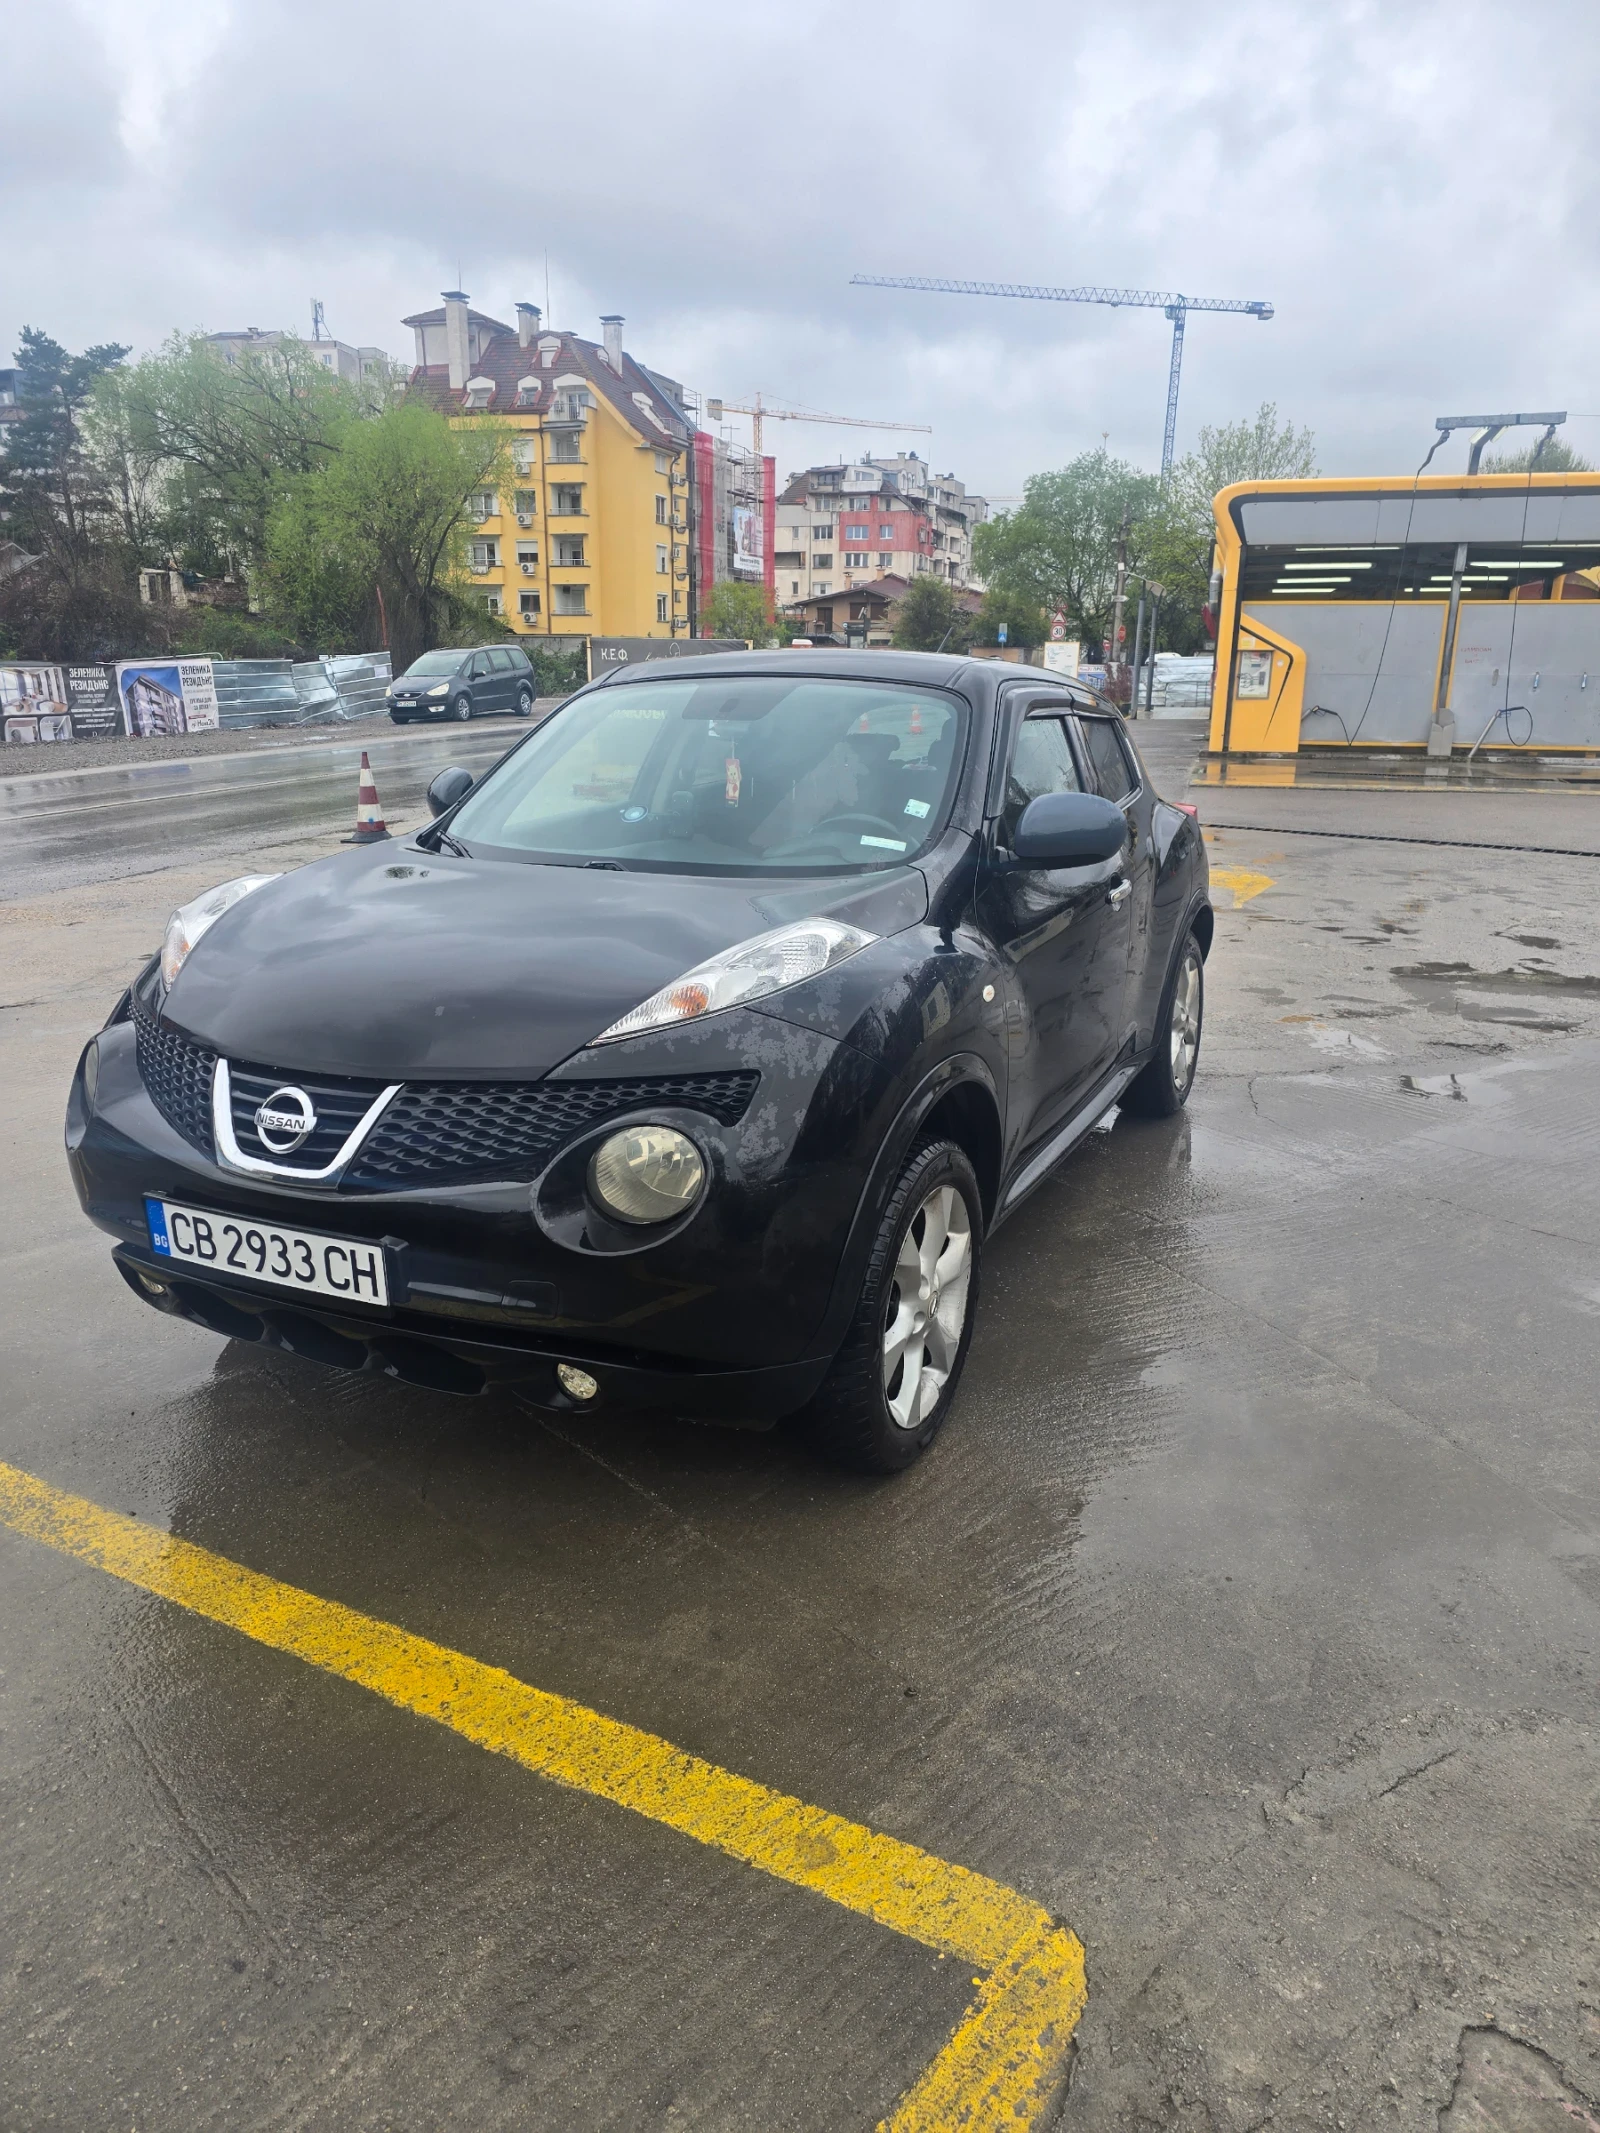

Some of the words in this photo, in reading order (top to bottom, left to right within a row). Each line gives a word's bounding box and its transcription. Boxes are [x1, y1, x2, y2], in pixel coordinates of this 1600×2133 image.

[1054, 627, 1063, 636] 30
[69, 668, 106, 678] ЗЕЛЕНИКА
[181, 665, 211, 675] ЗЕЛЕНИКА
[70, 679, 109, 692] РЕЗИДЪНС
[182, 676, 213, 687] РЕЗИДЪНС
[257, 1113, 305, 1129] NISSAN
[154, 1233, 168, 1248] BG
[171, 1212, 217, 1260] CB
[223, 1224, 316, 1283] 2933
[324, 1246, 379, 1298] CH
